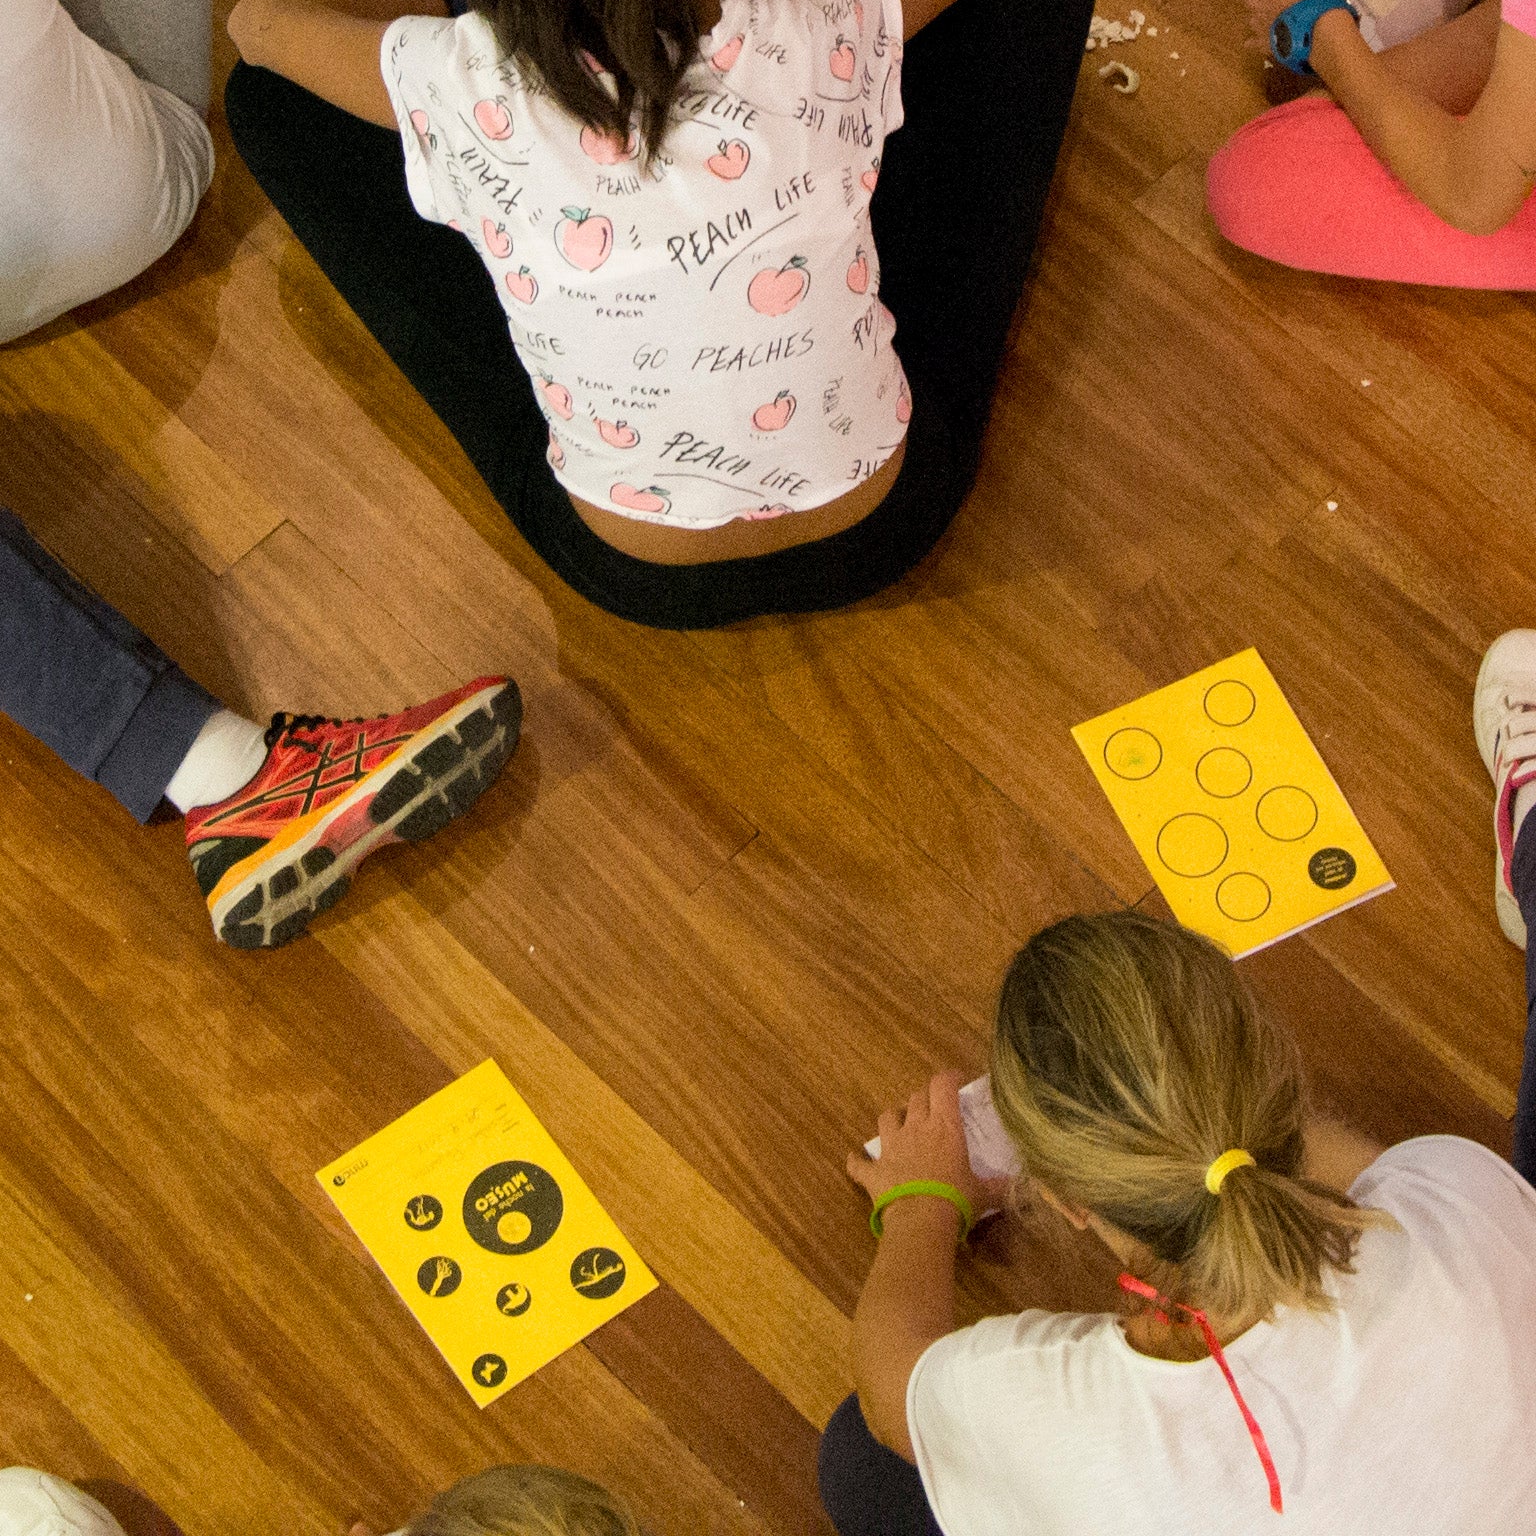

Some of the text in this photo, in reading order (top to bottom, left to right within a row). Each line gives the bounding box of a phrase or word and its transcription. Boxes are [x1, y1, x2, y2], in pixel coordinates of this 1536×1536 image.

[596, 175, 641, 196] PEACH
[667, 209, 752, 275] PEACH
[633, 344, 669, 370] GO
[691, 327, 814, 373] PEACHES
[660, 432, 751, 477] PEACH
[475, 1171, 528, 1212] MUSEO
